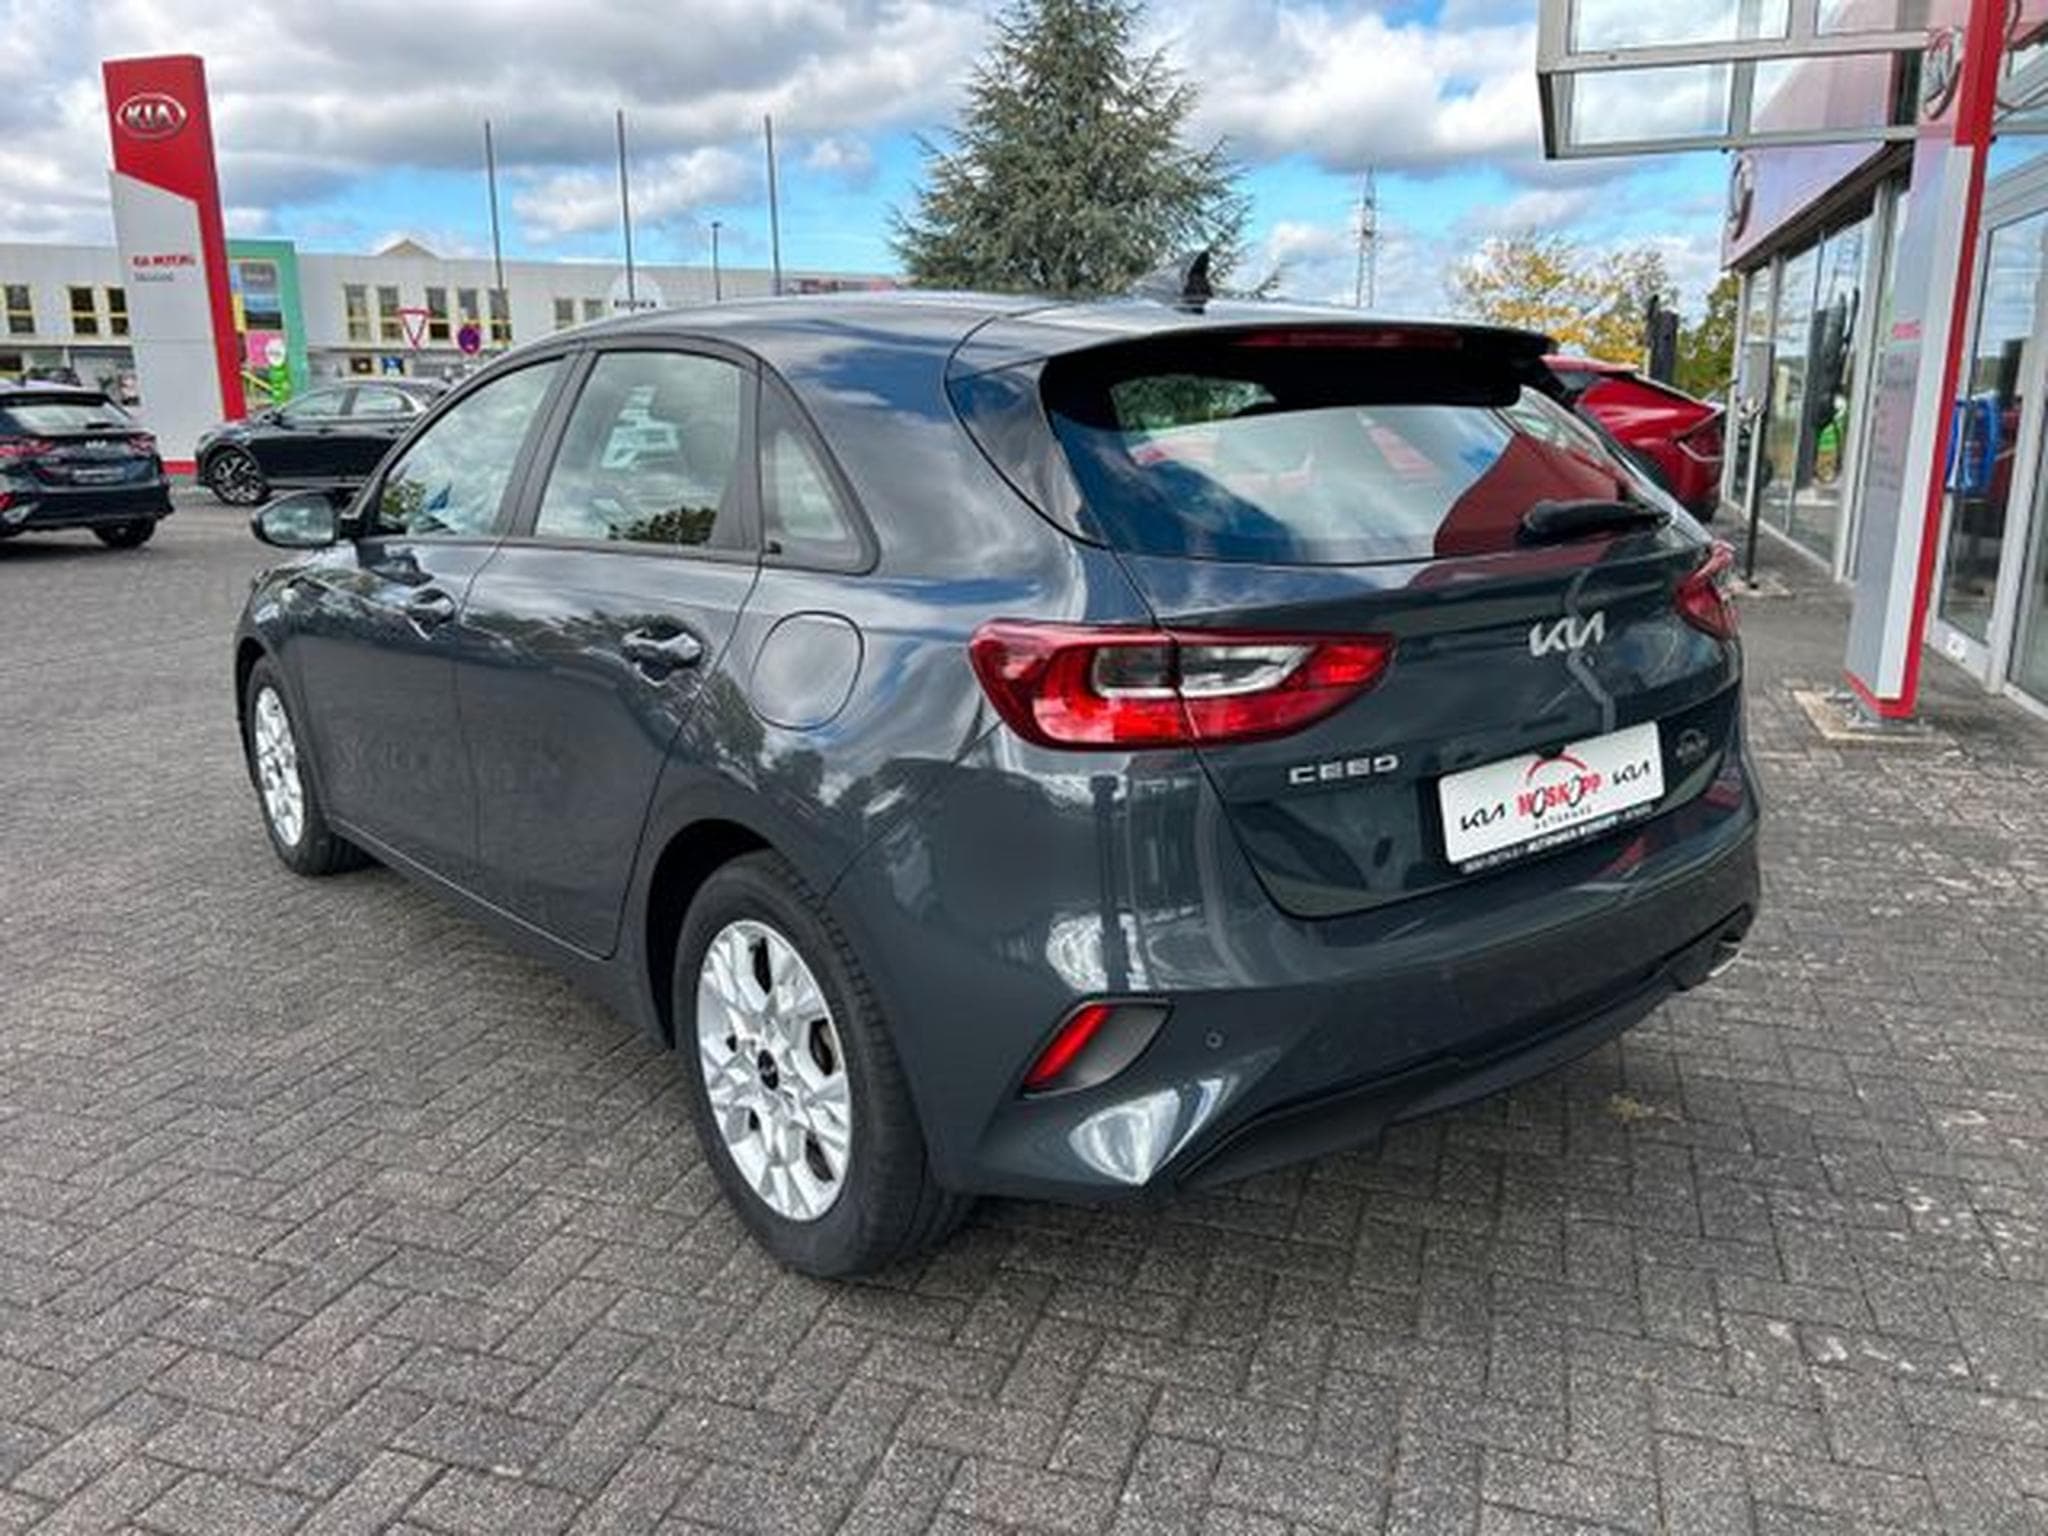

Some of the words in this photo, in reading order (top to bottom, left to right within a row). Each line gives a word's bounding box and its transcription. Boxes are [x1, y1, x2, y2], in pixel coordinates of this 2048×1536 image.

[126, 103, 175, 129] KIA
[1529, 611, 1605, 657] KIA
[1289, 755, 1398, 785] CEED
[1460, 803, 1506, 831] KIA
[1612, 760, 1650, 786] KIA
